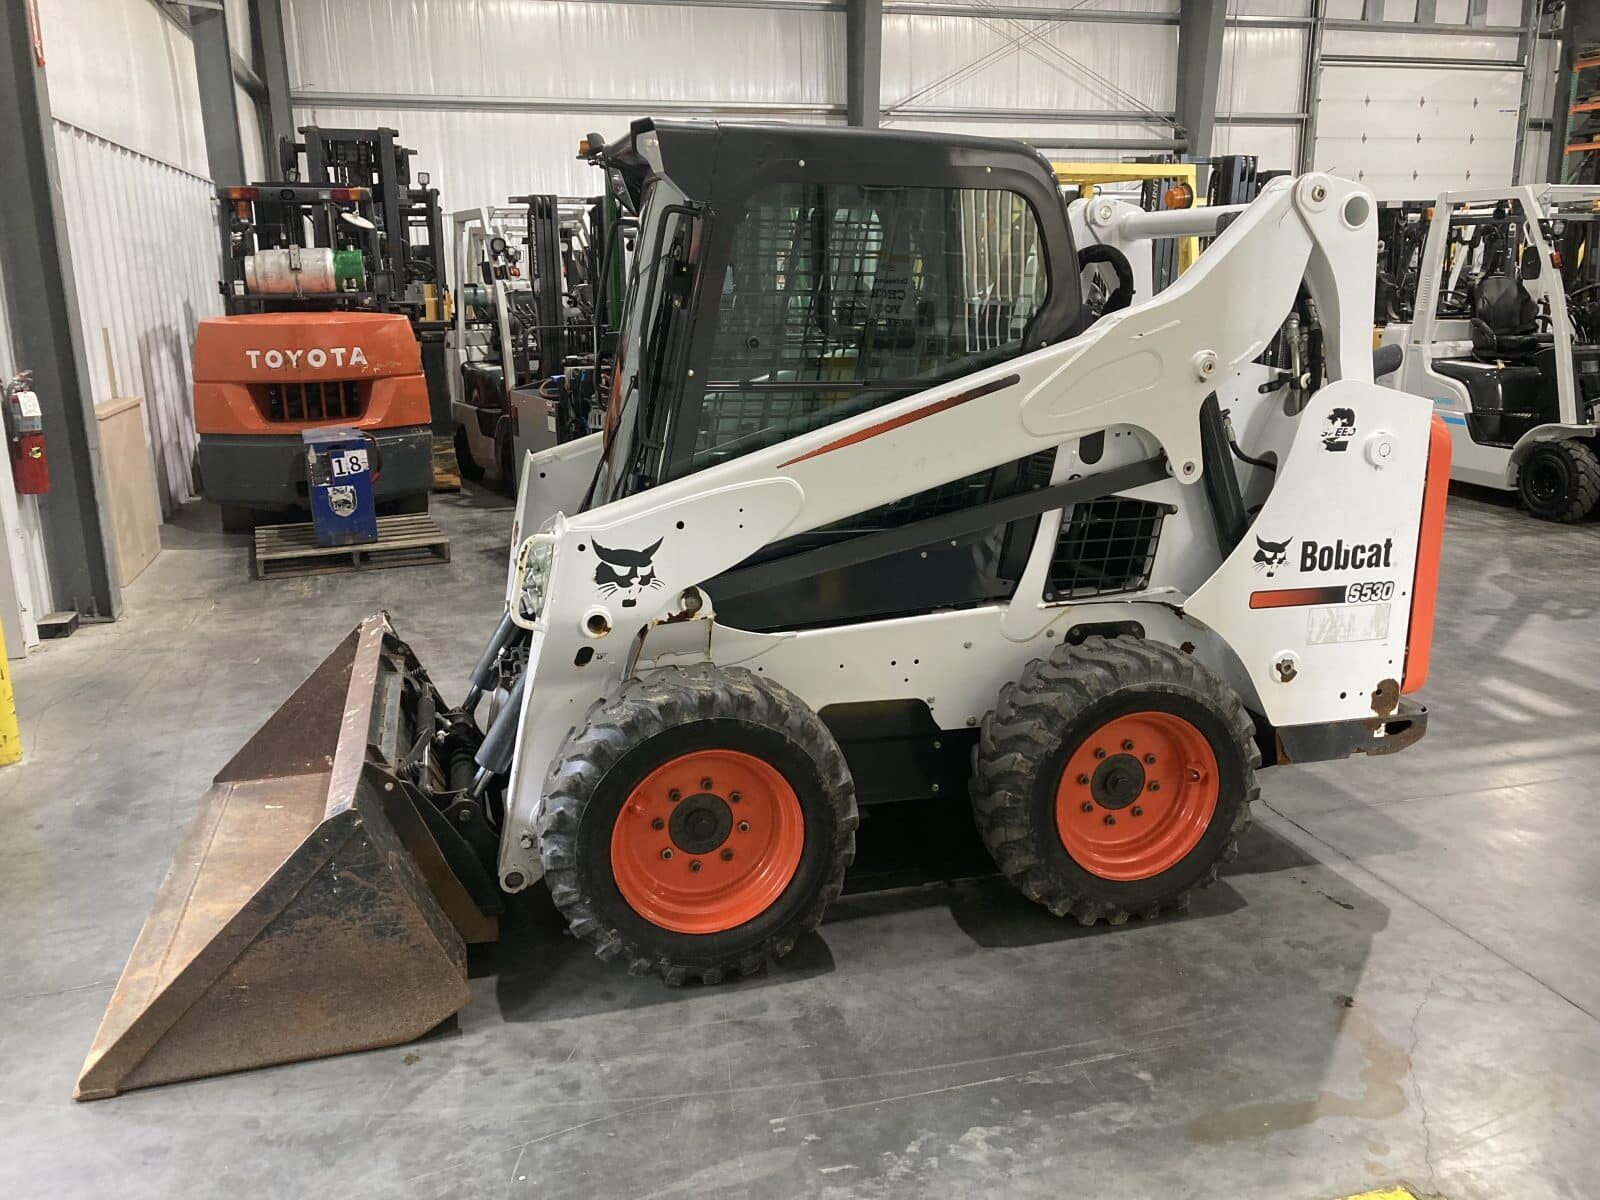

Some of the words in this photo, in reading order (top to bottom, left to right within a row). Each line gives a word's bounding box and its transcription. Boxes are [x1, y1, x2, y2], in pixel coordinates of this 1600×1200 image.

[246, 347, 368, 369] TOYOTA
[334, 456, 362, 475] 18
[1300, 537, 1393, 572] Bobcat
[1348, 581, 1395, 603] S530
